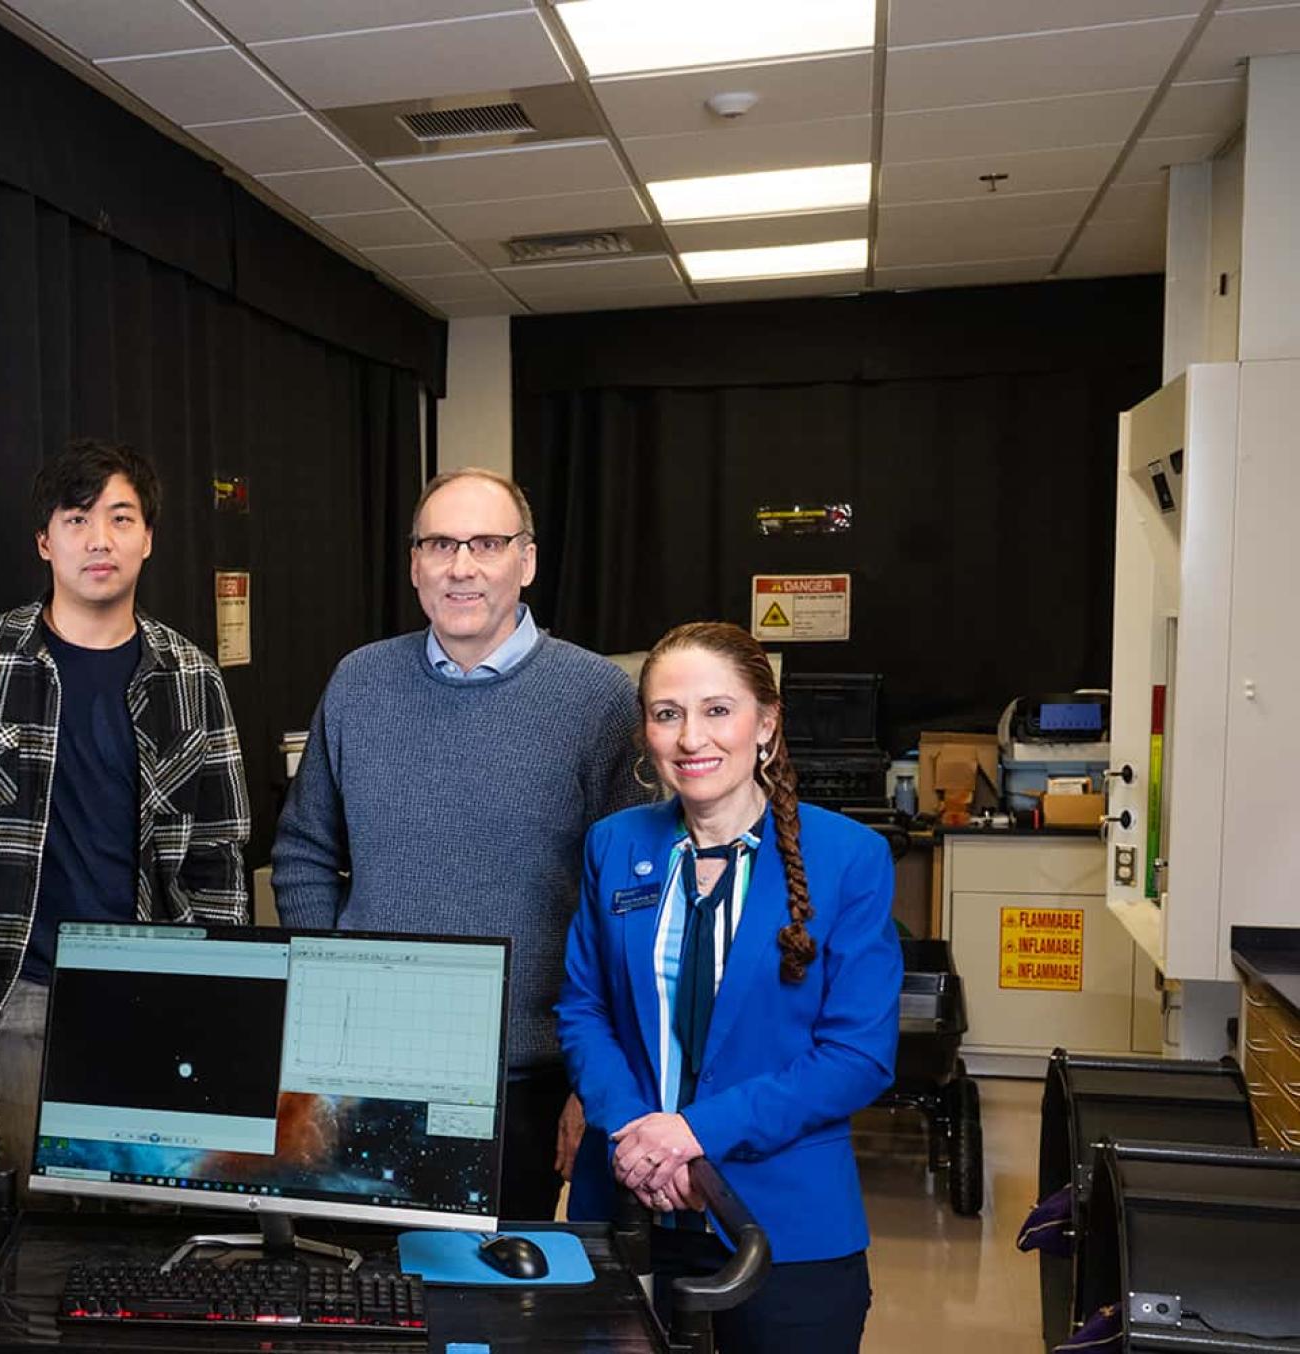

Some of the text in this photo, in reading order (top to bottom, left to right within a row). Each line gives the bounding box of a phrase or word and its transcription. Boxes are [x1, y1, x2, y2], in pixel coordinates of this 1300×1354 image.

[783, 580, 832, 592] DANGER
[1019, 912, 1081, 930] FLAMMABLE
[1018, 936, 1080, 955] INFLAMABLE
[1018, 962, 1079, 981] INFLAMMABLE
